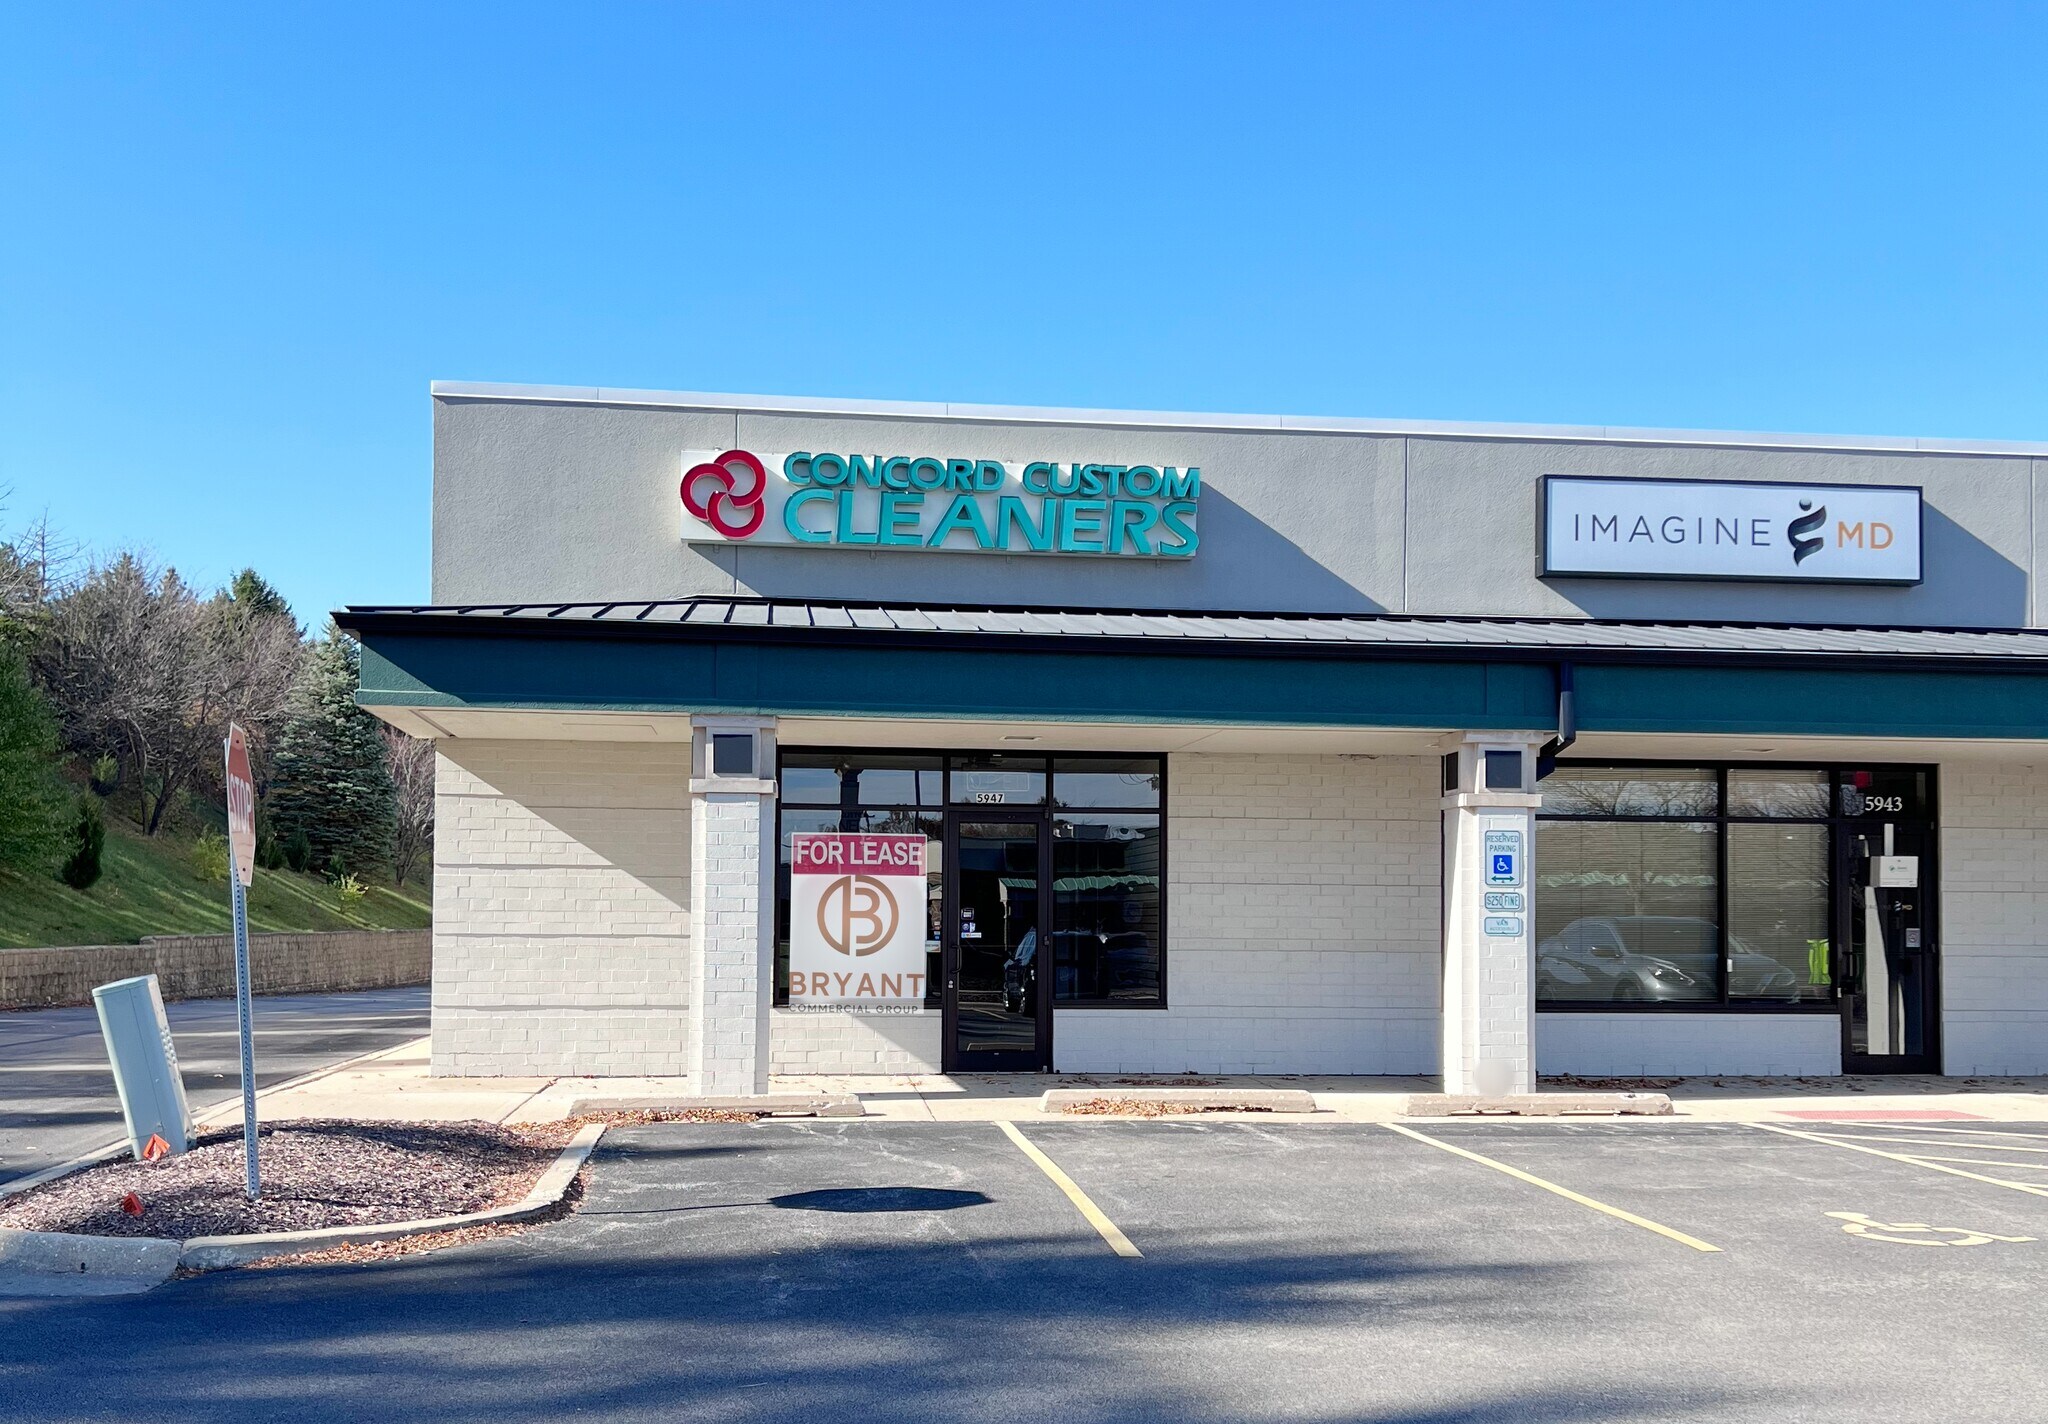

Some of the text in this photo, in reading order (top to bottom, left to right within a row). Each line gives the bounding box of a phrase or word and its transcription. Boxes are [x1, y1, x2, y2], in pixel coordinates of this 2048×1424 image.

[784, 451, 1200, 499] CONCORD CUSTOM
[784, 489, 1199, 556] CLEANERS
[1574, 513, 1894, 549] IMAGINE MD
[229, 773, 251, 834] STOP
[977, 794, 1004, 803] 5947
[1864, 796, 1903, 811] 5943
[1486, 834, 1519, 843] RESERVED
[1489, 844, 1517, 853] PARKING
[797, 840, 923, 866] FOR LEASE
[1504, 895, 1519, 907] FINE
[789, 971, 925, 998] BRYANT
[788, 1003, 919, 1014] COMMERCIAL GROUP
